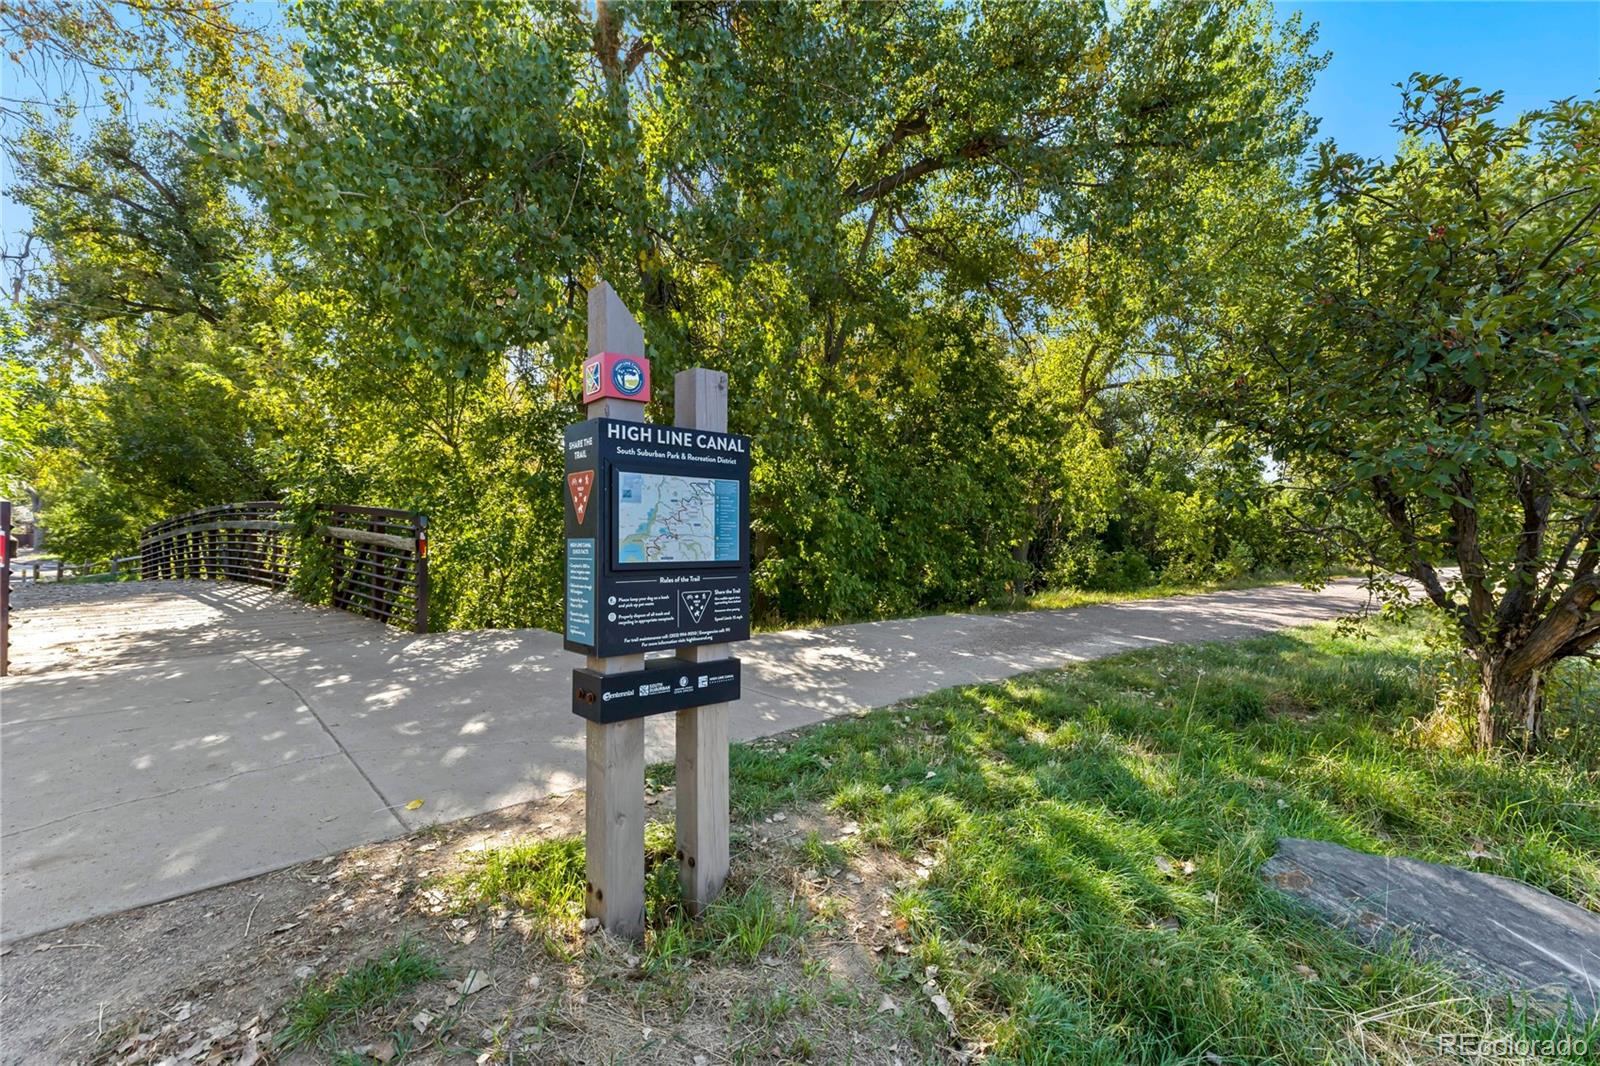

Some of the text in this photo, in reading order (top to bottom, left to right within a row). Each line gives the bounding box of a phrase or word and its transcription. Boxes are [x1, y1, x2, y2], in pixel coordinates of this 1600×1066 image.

[568, 437, 593, 450] SHARE THE
[608, 423, 744, 453] HIGH LINE CANAL
[574, 450, 587, 459] TRAIL
[616, 447, 636, 456] South
[637, 448, 666, 458] Suburban
[666, 451, 680, 460] Park
[687, 454, 716, 463] Recreation
[717, 456, 736, 465] District
[602, 690, 634, 701] Centennial
